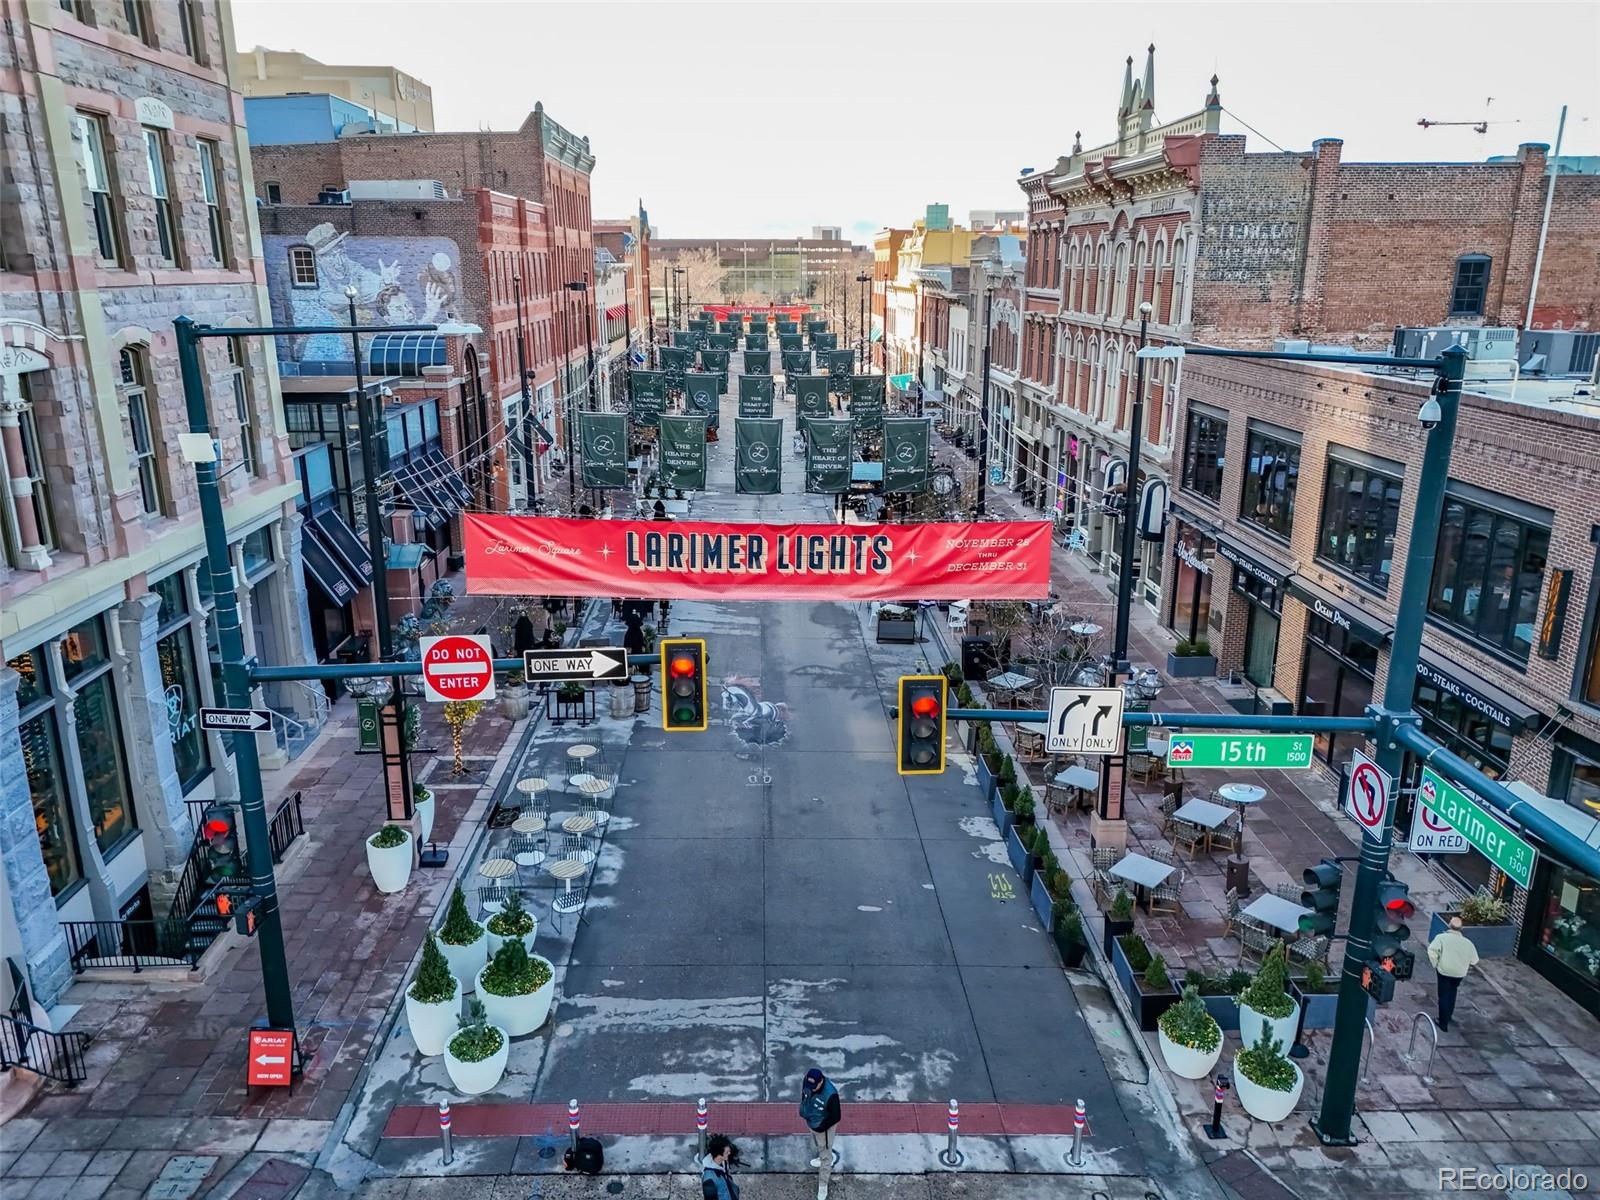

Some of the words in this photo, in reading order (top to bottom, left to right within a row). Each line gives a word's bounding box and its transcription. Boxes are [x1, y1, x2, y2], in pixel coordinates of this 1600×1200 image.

[674, 442, 691, 450] THE
[664, 450, 690, 458] HEART
[485, 538, 532, 556] Larimer
[538, 540, 581, 559] Square
[945, 538, 1015, 550] NOVEMBER
[625, 530, 769, 575] LARIMER
[776, 533, 893, 576] LIGHTS
[946, 561, 1015, 573] DECEMBER
[1015, 561, 1028, 571] 31
[1254, 567, 1278, 587] COCKTAILS
[431, 648, 449, 660] DO
[455, 647, 481, 660] NOT
[533, 659, 558, 672] ONE
[565, 656, 593, 670] WAY
[439, 676, 479, 689] ENTER
[1432, 672, 1460, 697] STEAKS
[1465, 692, 1511, 728] COCKTAILS
[208, 714, 228, 724] ONE
[230, 716, 250, 725] WAY
[169, 714, 197, 744] RIAT
[1051, 737, 1079, 748] ONLY
[1085, 737, 1113, 749] ONLY
[1292, 741, 1303, 751] St
[1220, 741, 1266, 762] 15th
[1286, 752, 1306, 762] 1500
[1439, 789, 1507, 860] Larimer
[1416, 834, 1433, 847] ON
[1438, 835, 1463, 848] RED
[1516, 847, 1525, 862] St
[1509, 855, 1528, 878] 1300
